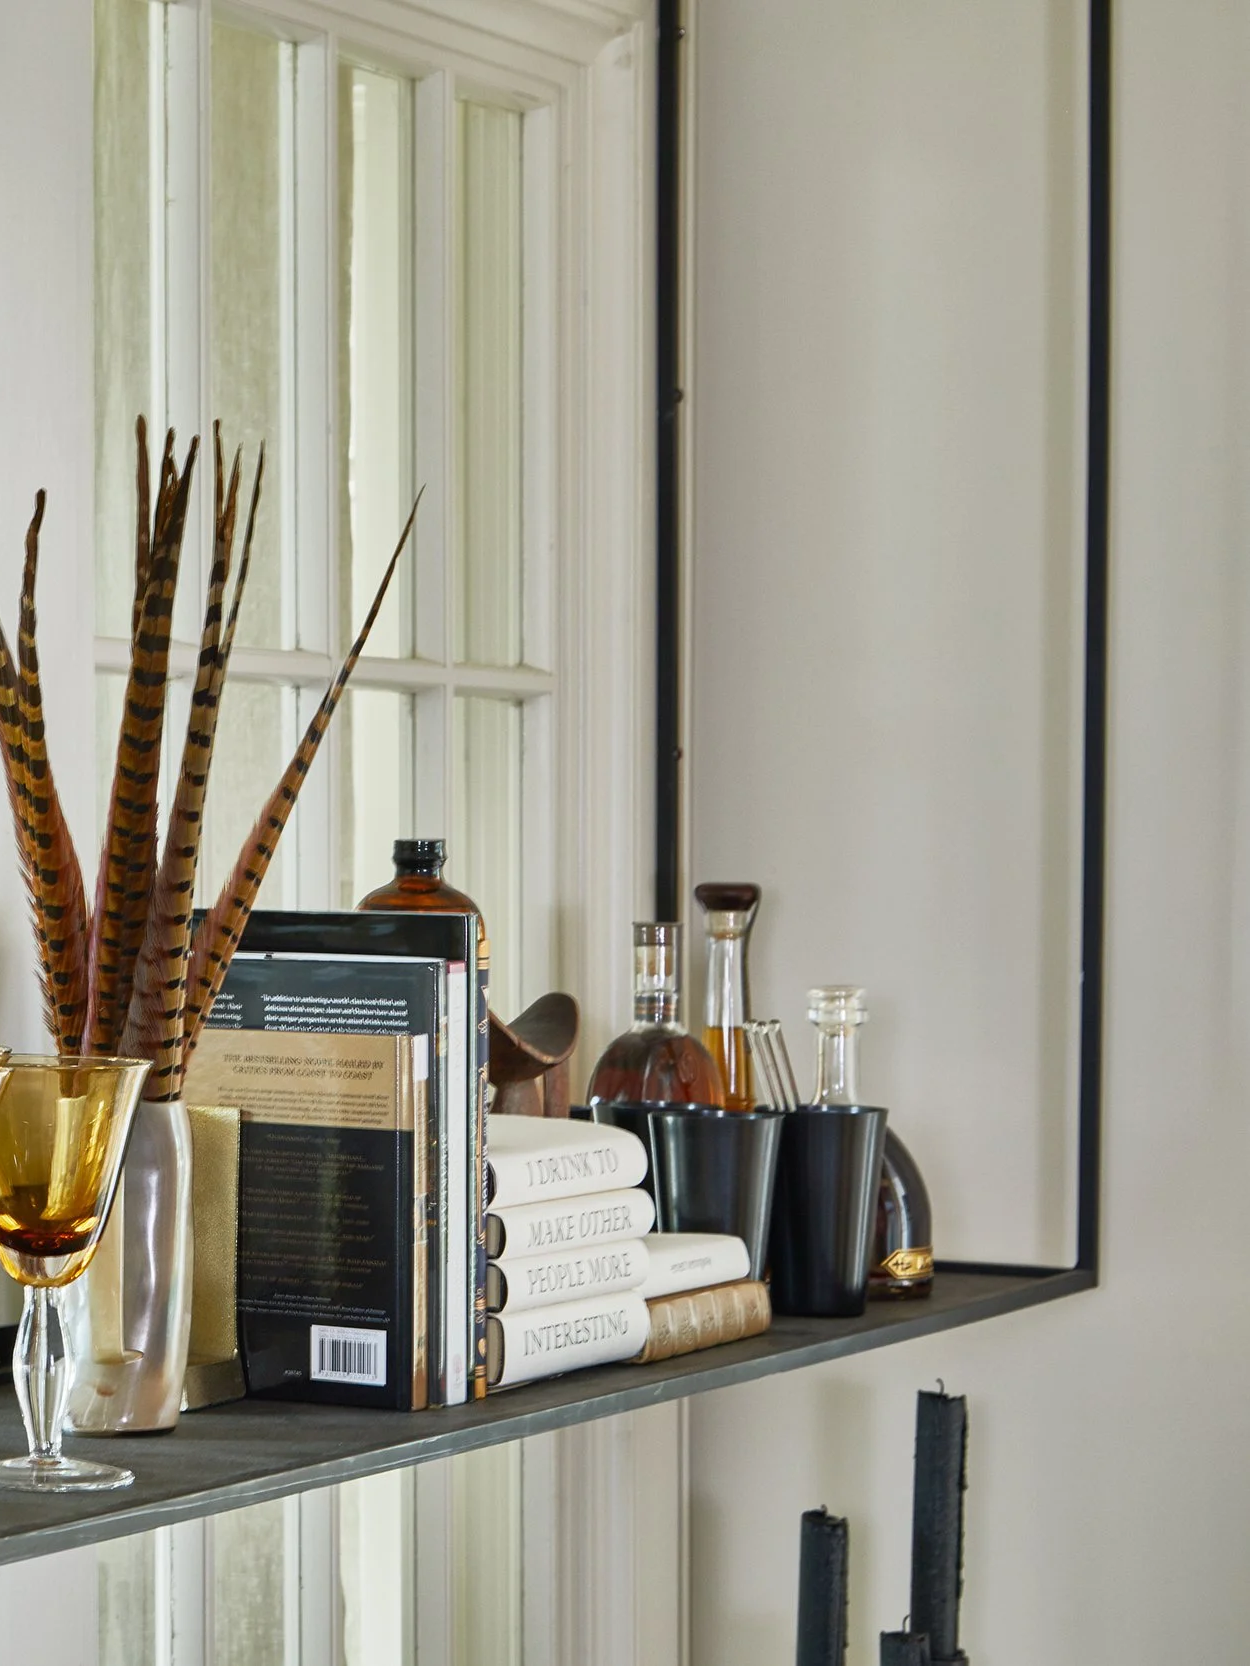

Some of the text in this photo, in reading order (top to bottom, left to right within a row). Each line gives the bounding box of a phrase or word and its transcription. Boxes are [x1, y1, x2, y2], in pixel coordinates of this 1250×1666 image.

[526, 1148, 619, 1187] I DRINK TO
[527, 1205, 632, 1248] MAKE OTHER
[527, 1260, 585, 1295] PEOPLE
[587, 1252, 632, 1284] MORE
[523, 1309, 629, 1357] INTERESTING
